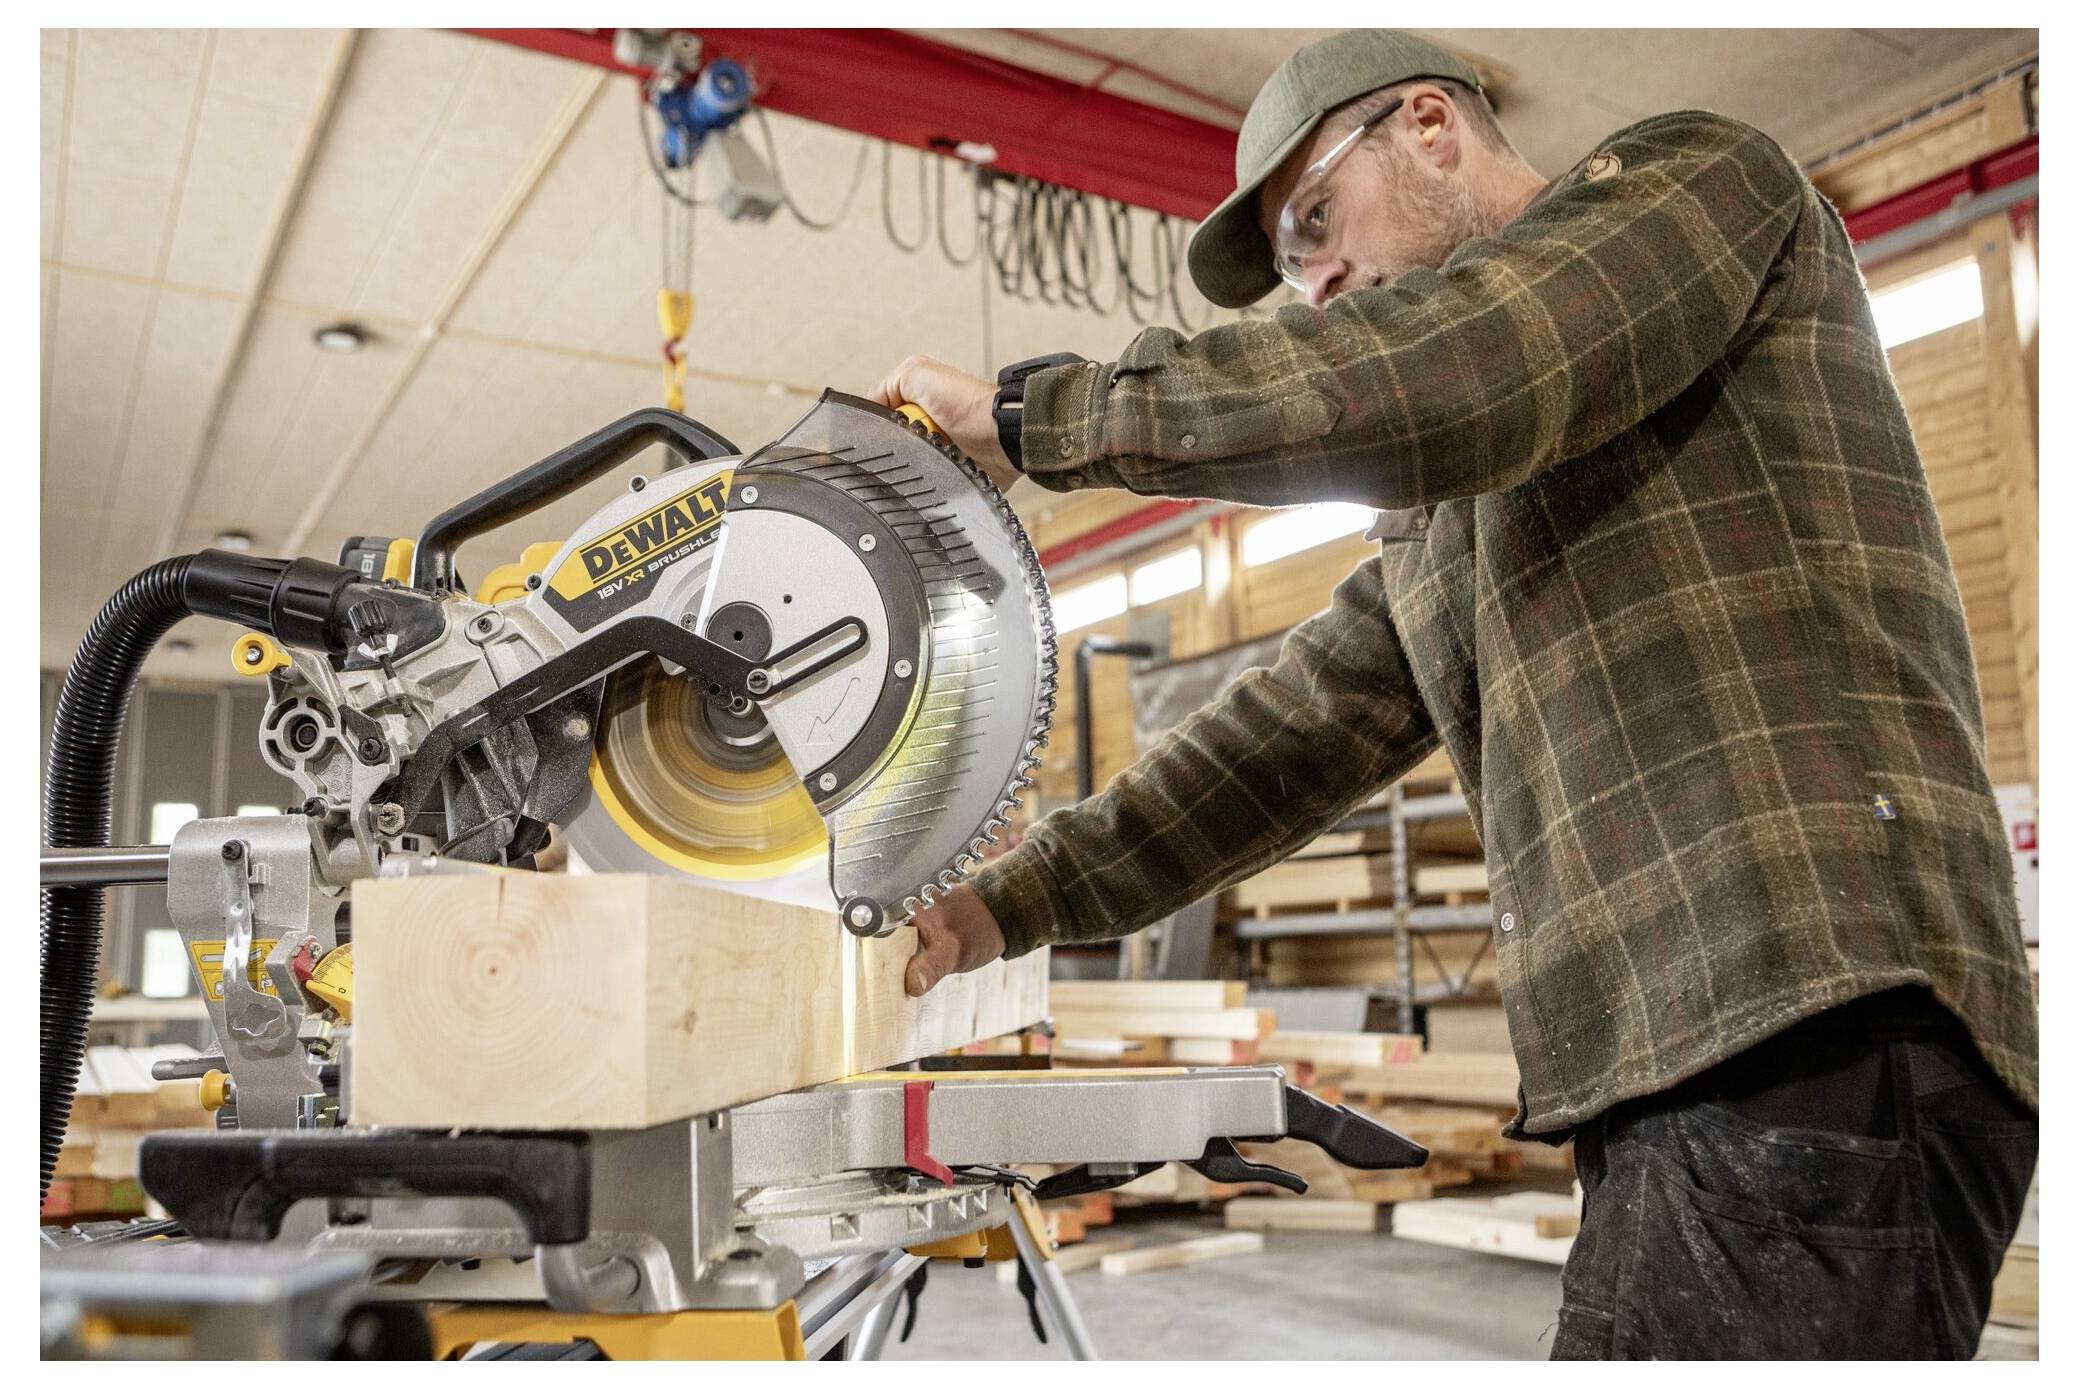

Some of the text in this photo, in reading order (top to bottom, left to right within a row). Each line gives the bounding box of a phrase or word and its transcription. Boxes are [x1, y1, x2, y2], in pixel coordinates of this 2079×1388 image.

[581, 481, 726, 579] DEWALT
[597, 578, 622, 600] 18V
[624, 569, 646, 586] XR
